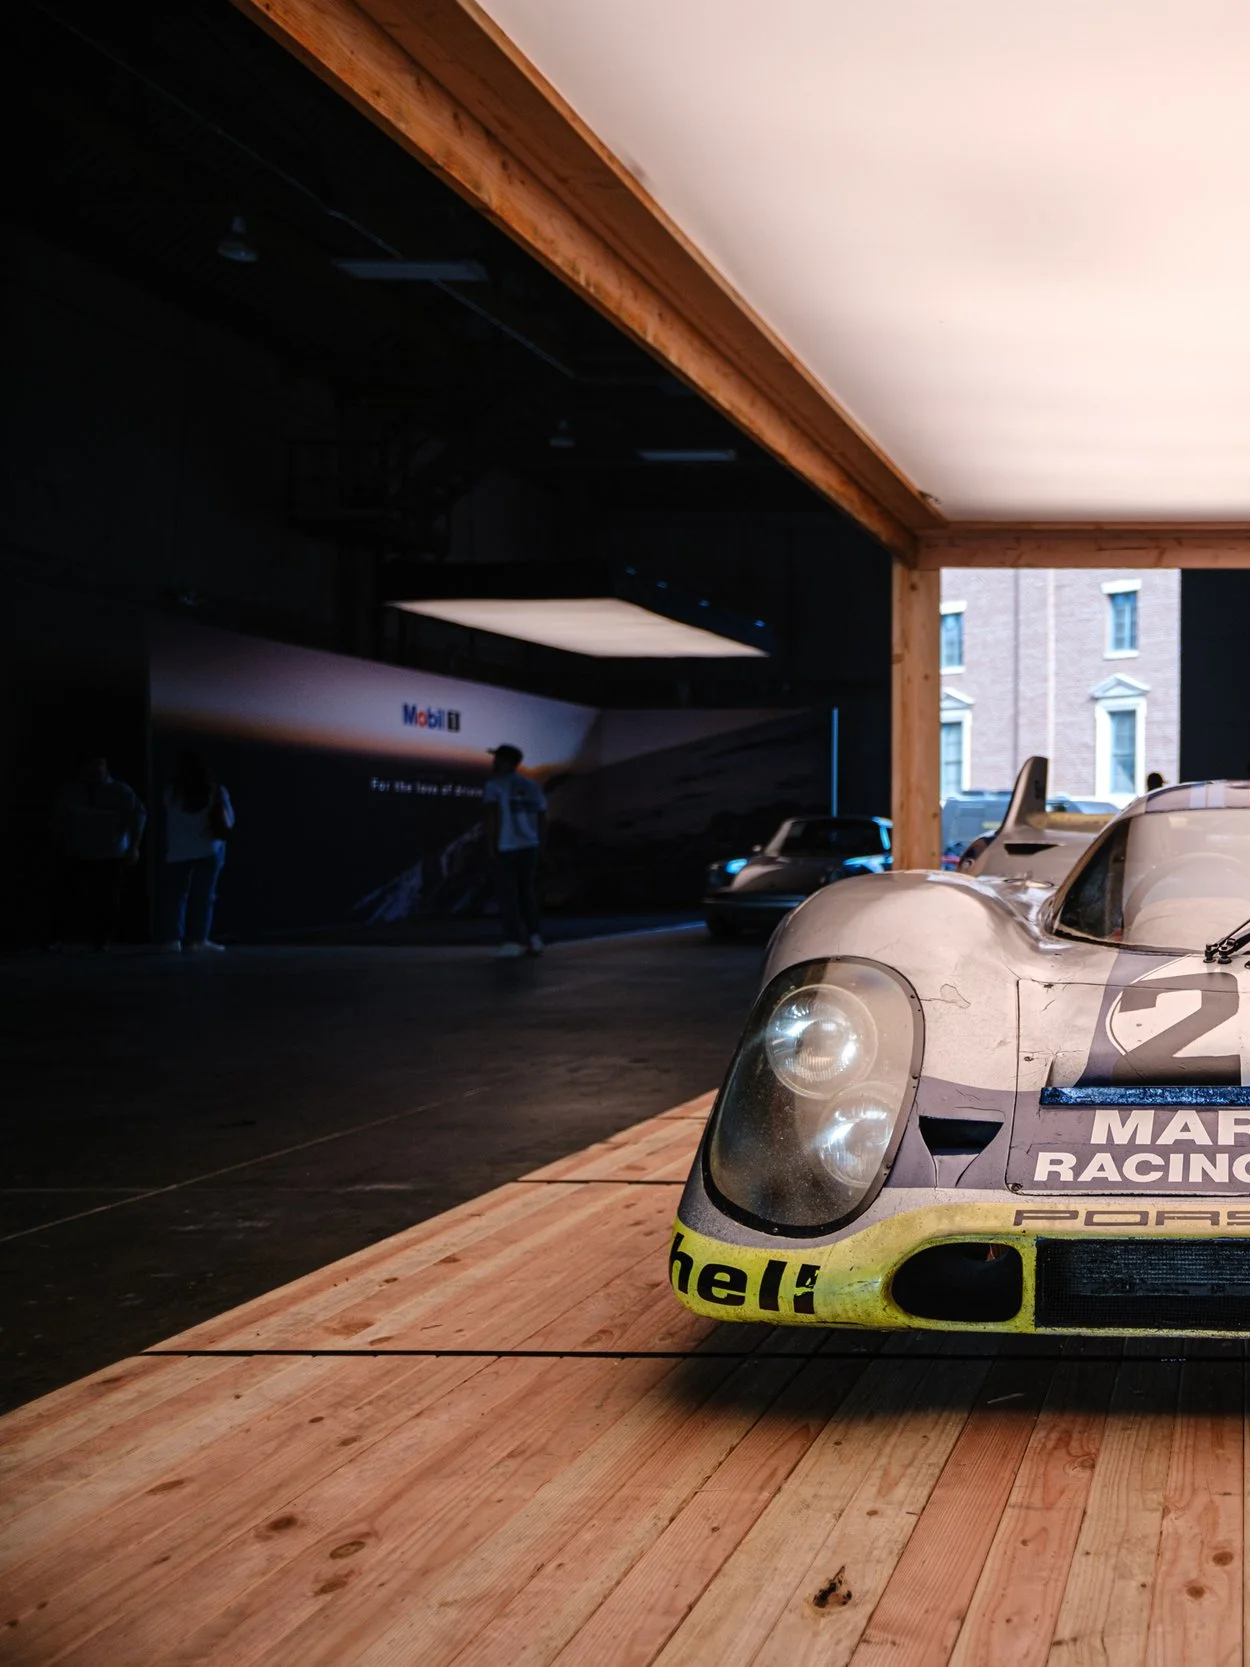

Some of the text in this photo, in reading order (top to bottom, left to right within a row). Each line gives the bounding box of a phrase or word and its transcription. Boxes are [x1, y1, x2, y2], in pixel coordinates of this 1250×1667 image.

[403, 704, 460, 732] Mobil 1
[371, 776, 482, 798] For the love of drivin
